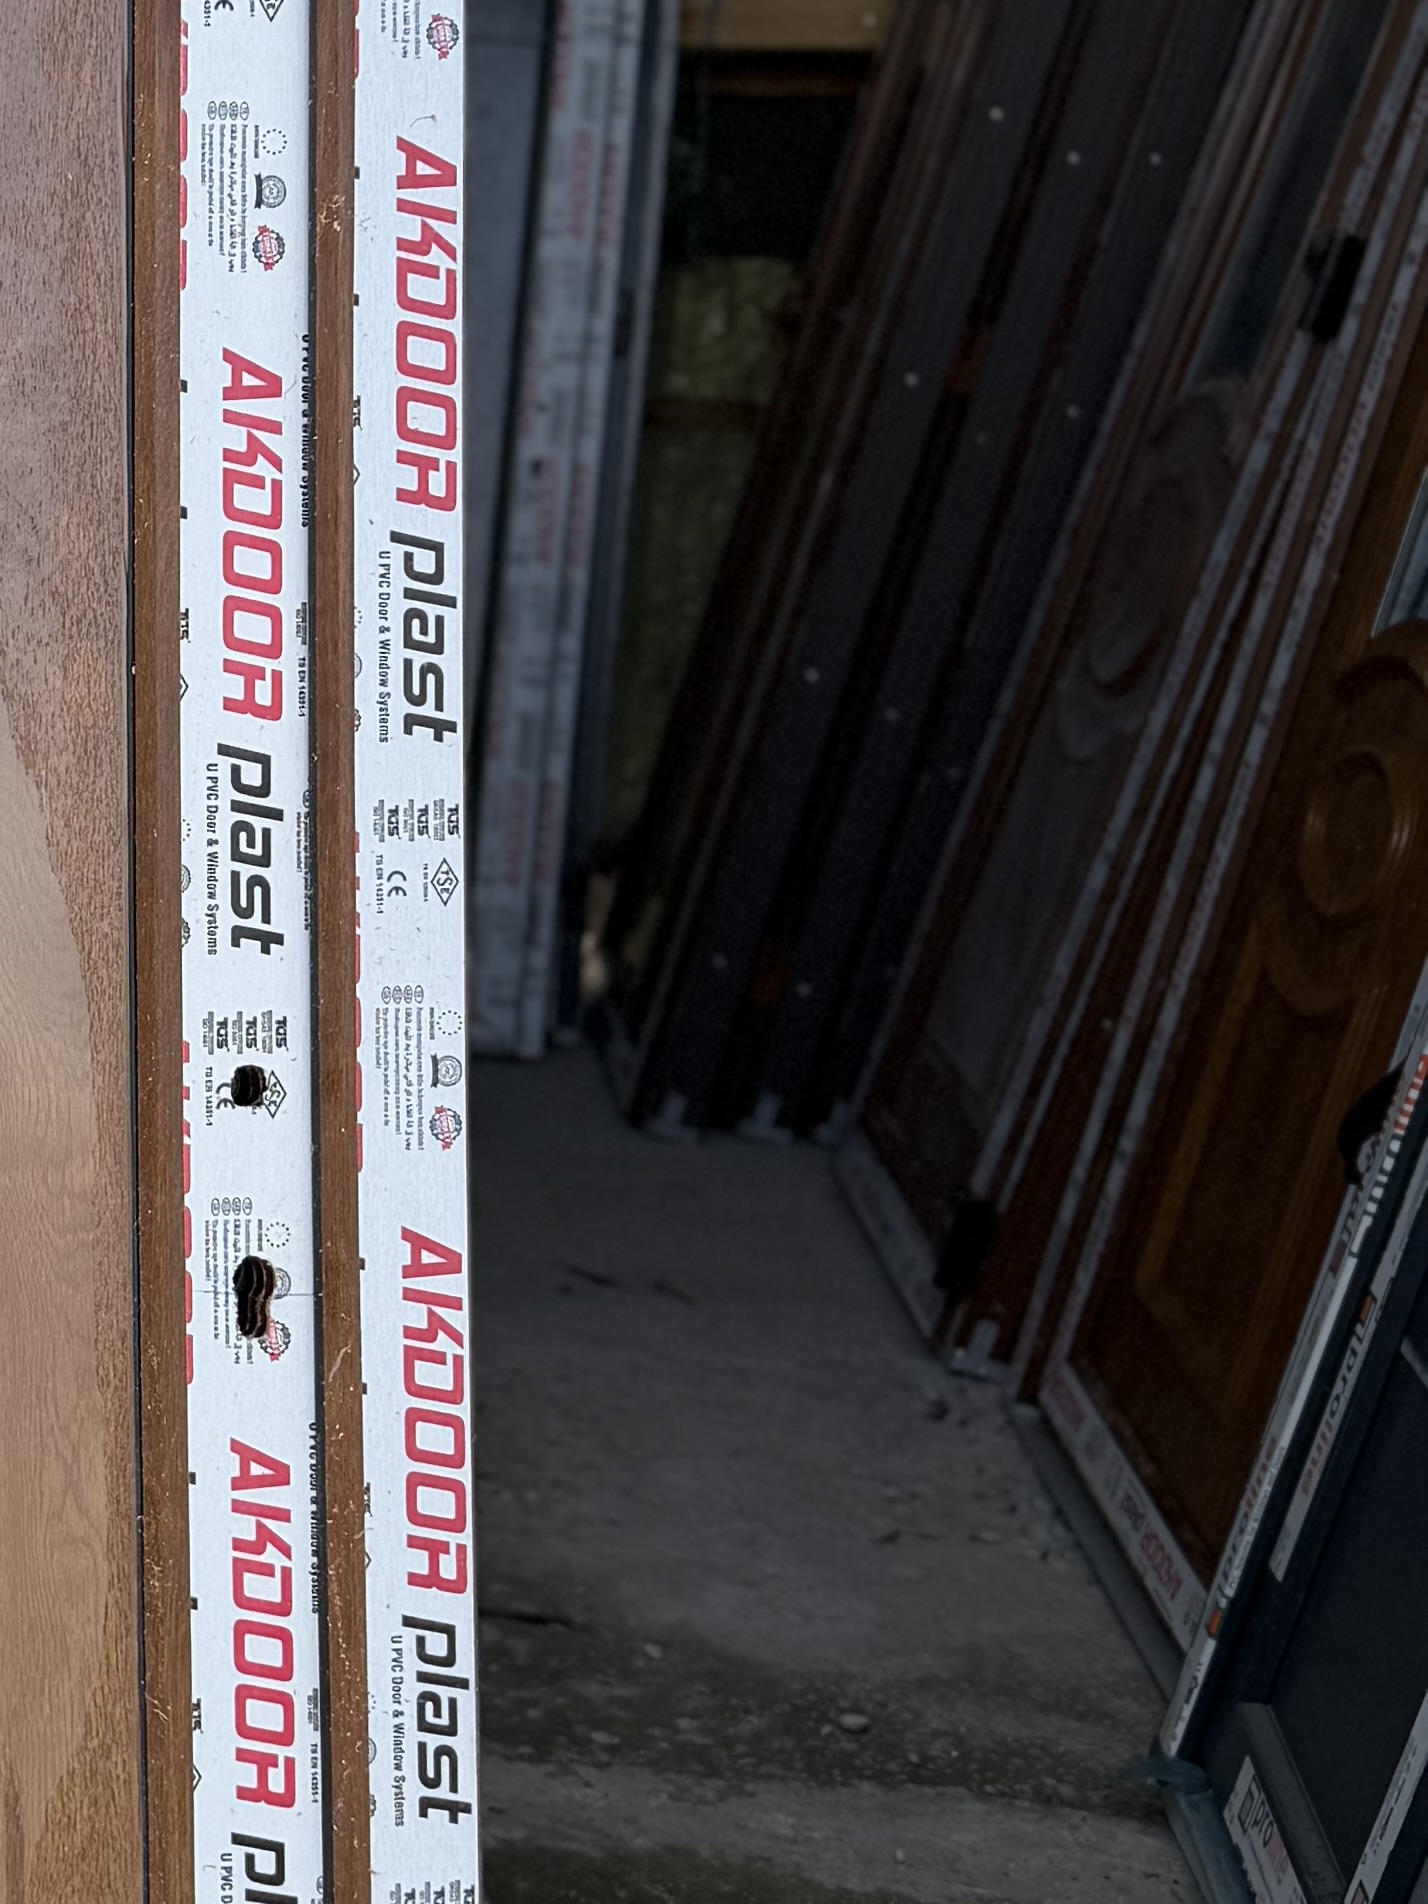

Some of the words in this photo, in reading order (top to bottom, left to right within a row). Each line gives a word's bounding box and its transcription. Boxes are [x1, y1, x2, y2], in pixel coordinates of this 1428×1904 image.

[395, 139, 457, 512] AKDOOR
[221, 349, 282, 722] AKDOOR
[378, 550, 391, 560] U
[378, 563, 391, 589] PVC
[378, 592, 391, 622] Door
[378, 625, 391, 634] &
[388, 530, 458, 743] plast
[378, 638, 391, 688] Window
[376, 691, 392, 743] Systems
[214, 742, 285, 956] plast
[401, 1228, 467, 1595] AKDOOR
[229, 1440, 296, 1809] AKDOOR
[399, 1614, 473, 1825] plast
[220, 1852, 233, 1862] U
[220, 1865, 234, 1892] PVC
